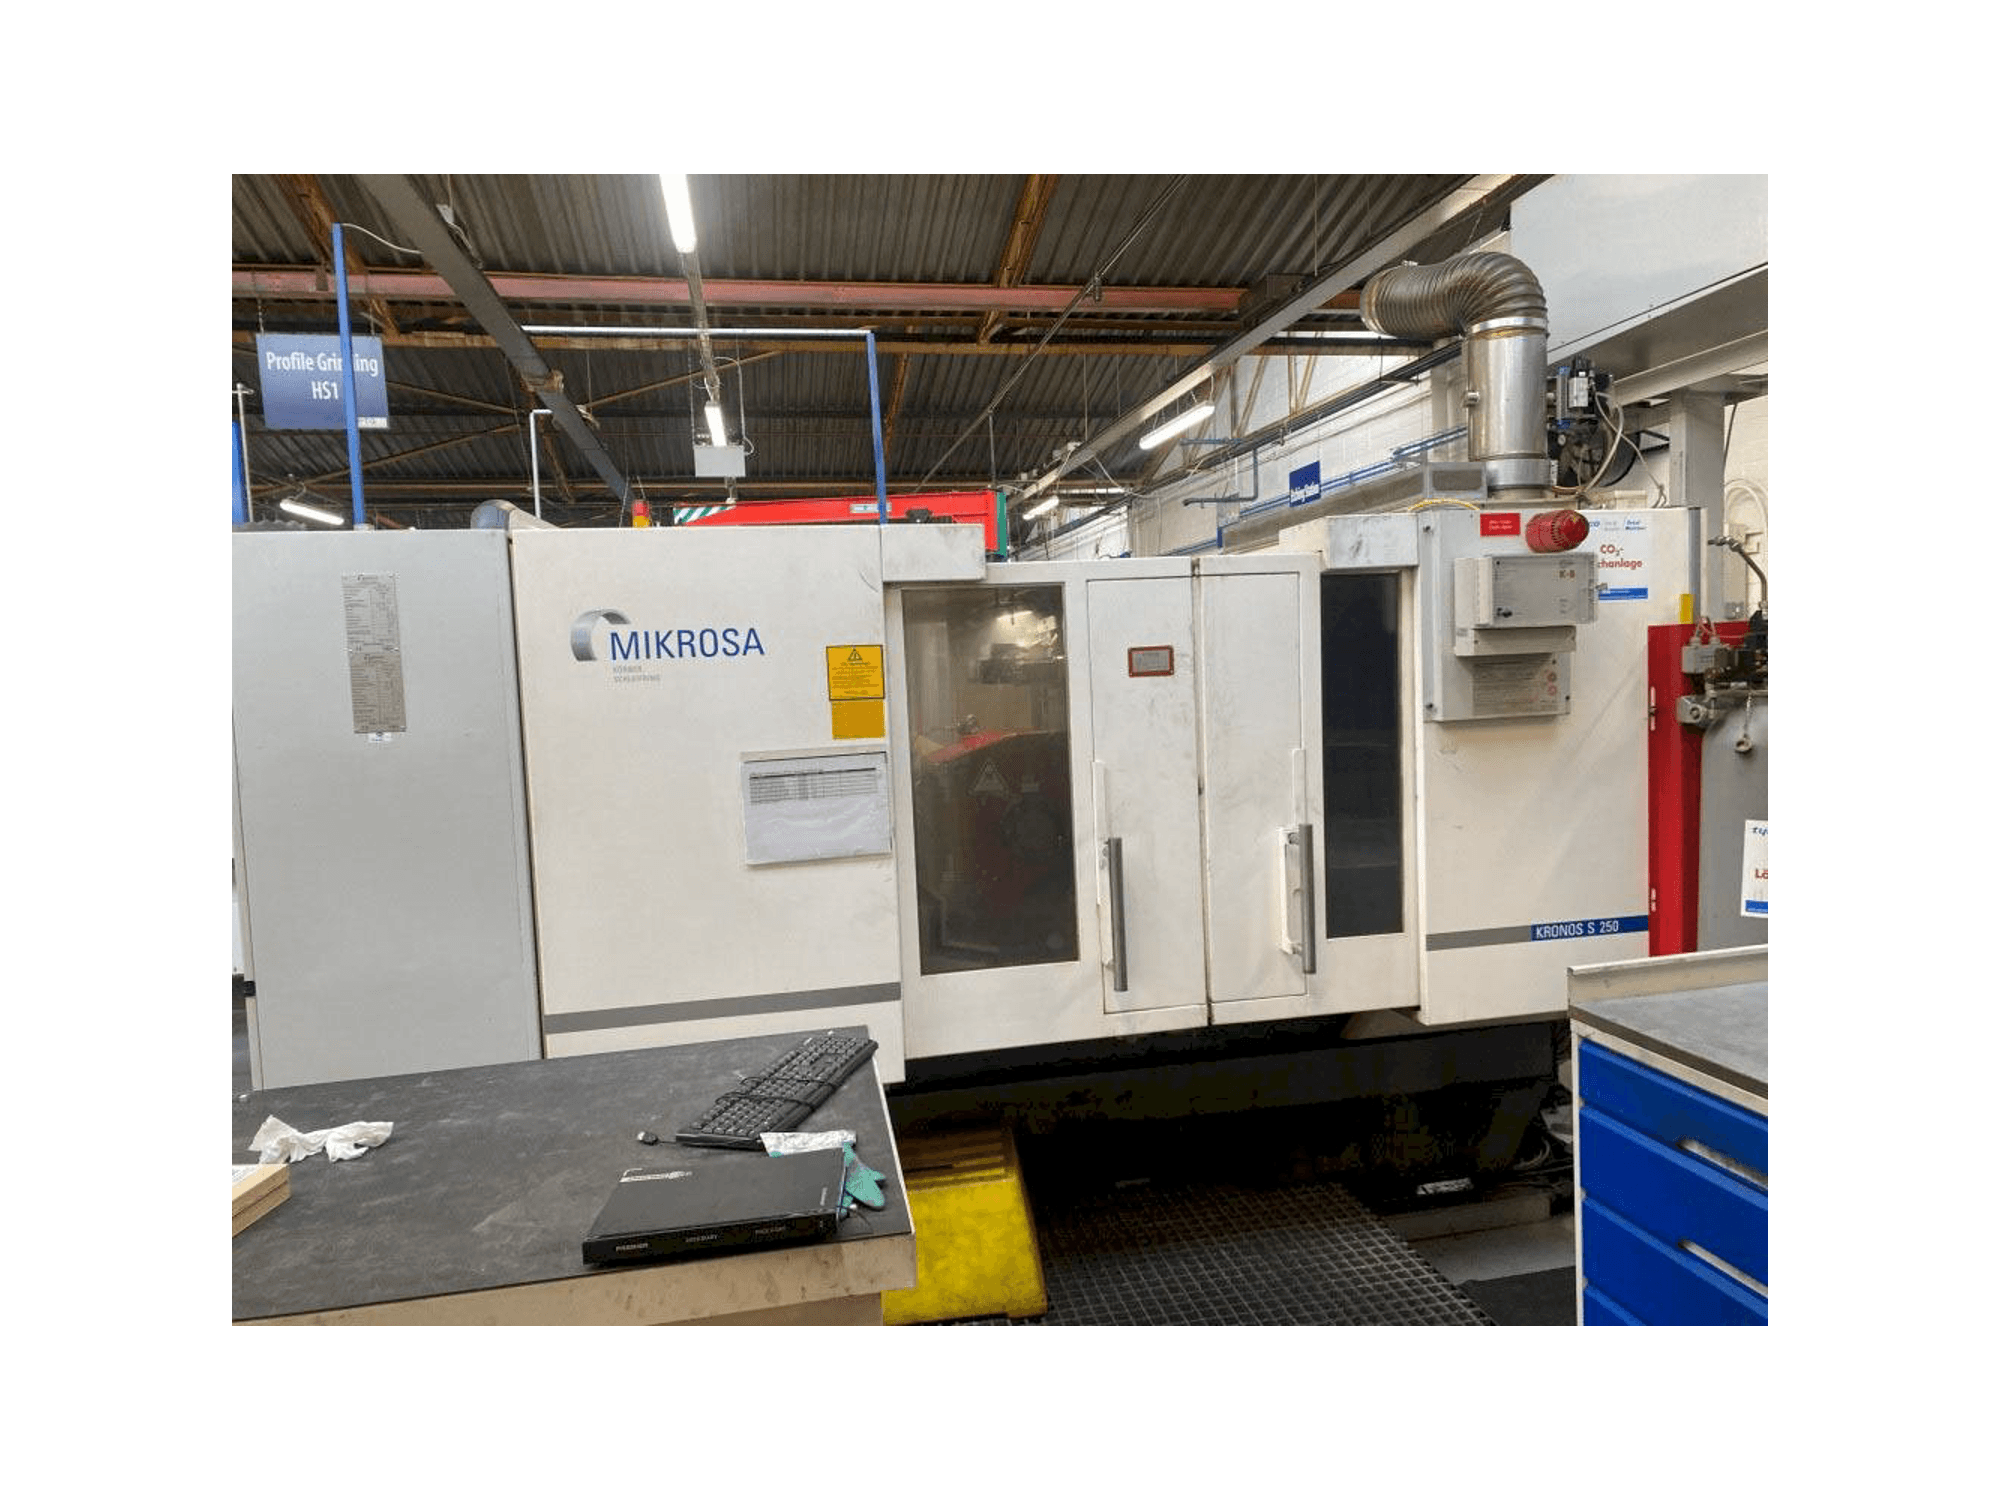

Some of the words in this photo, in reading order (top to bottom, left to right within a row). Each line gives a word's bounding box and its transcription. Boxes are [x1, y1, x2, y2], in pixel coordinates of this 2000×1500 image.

[266, 351, 314, 371] Profile
[317, 352, 378, 377] Griing
[311, 380, 338, 400] HS1
[610, 627, 765, 661] MIKROSA
[1536, 922, 1584, 939] KRONOS
[1587, 921, 1595, 935] S
[1599, 920, 1619, 933] 250
